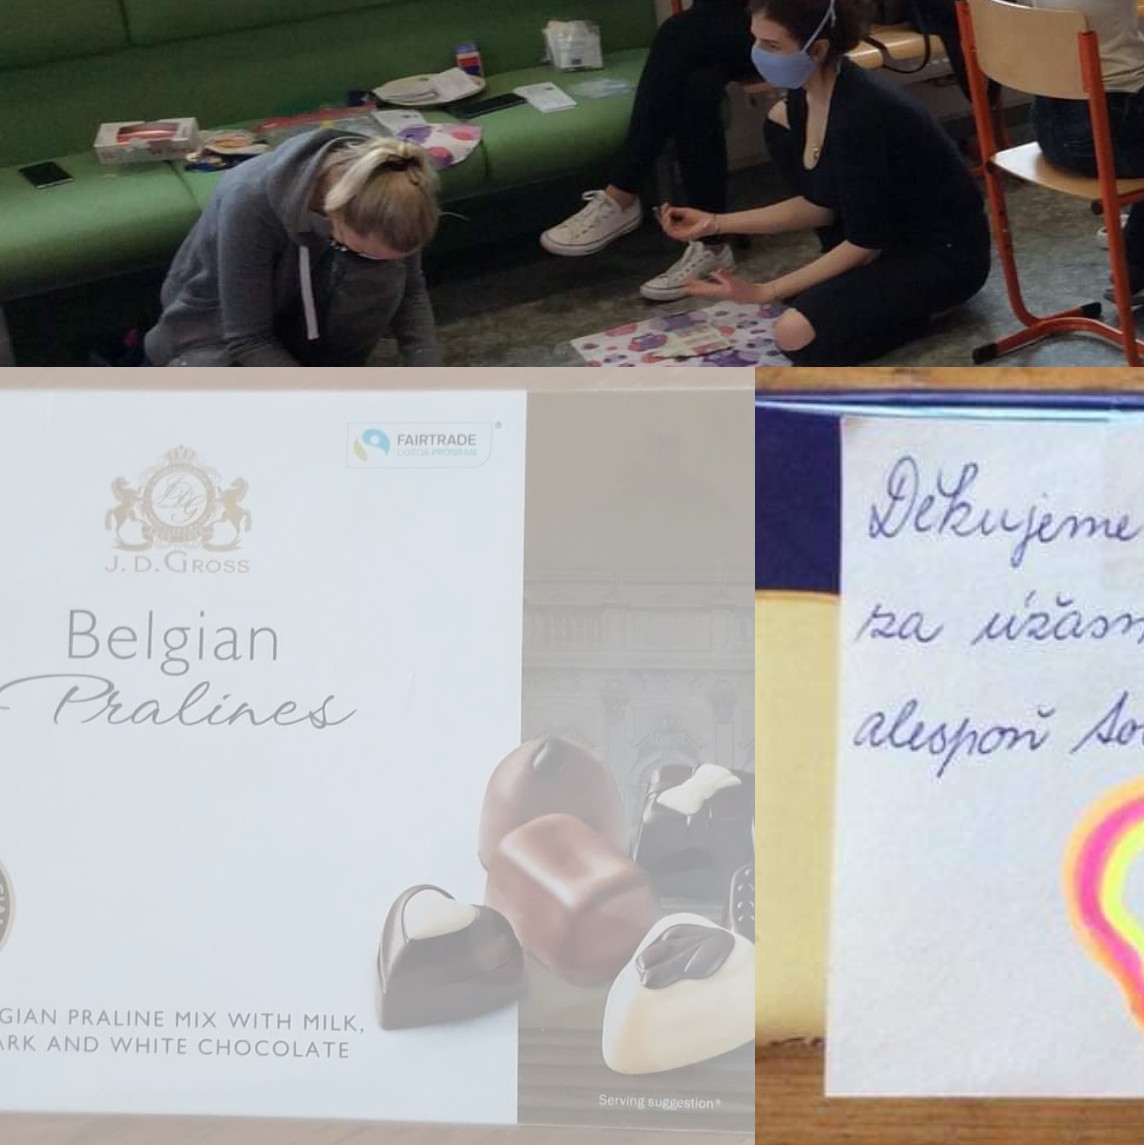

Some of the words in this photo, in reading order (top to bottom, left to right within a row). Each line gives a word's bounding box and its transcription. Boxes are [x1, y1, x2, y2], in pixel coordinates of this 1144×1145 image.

[397, 434, 476, 446] FAIRTRADE
[432, 448, 477, 456] PROGRAM
[869, 455, 1143, 568] Děkujeme
[857, 604, 945, 644] za
[68, 609, 277, 676] Belgian
[0, 673, 357, 729] Pralines
[852, 692, 1056, 778] alespoň
[0, 1007, 56, 1024] GIAN
[68, 1009, 164, 1027] PRALINE
[175, 1011, 217, 1028] MIX
[228, 1012, 291, 1030] WITH
[303, 1014, 365, 1033] MILK,
[48, 1035, 99, 1053] AND
[110, 1037, 187, 1055] WHITE
[198, 1038, 349, 1058] CHOCOLATE
[599, 1094, 645, 1109] Serving
